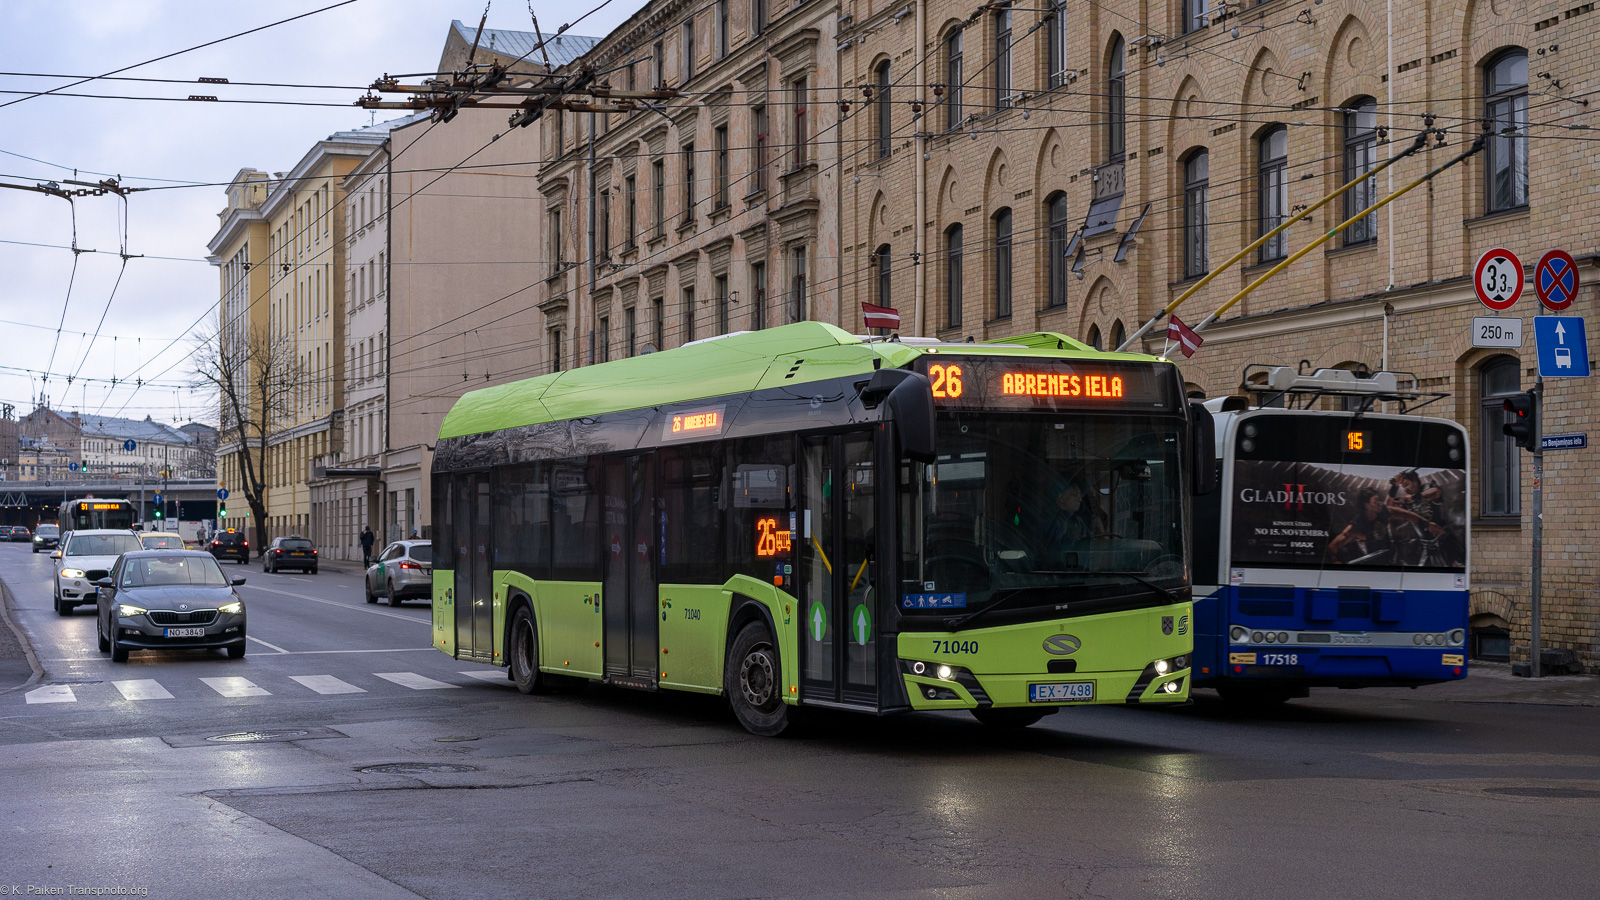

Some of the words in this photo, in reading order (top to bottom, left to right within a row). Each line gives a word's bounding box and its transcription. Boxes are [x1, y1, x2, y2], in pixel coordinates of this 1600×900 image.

[1481, 325, 1502, 339] 250
[1504, 331, 1514, 339] m
[929, 364, 963, 398] 26
[1002, 372, 1081, 397] ABRENES
[1085, 376, 1122, 398] IELA
[672, 416, 681, 432] 26
[683, 414, 705, 430] ABRENES
[705, 412, 717, 427] IELA
[1347, 431, 1363, 450] 15
[1548, 438, 1573, 447] Benjamiņas
[1573, 437, 1582, 445] iela
[1240, 488, 1346, 506] GLADIATORS
[81, 503, 88, 511] 51
[757, 518, 776, 556] 26
[1269, 528, 1281, 536] 15.
[1281, 529, 1330, 537] NOVEMBRA
[684, 608, 701, 621] 71040
[169, 628, 204, 636] NO-3849
[932, 640, 979, 655] 71040
[1263, 654, 1298, 665] 17518
[1038, 684, 1091, 698] EX-7498
